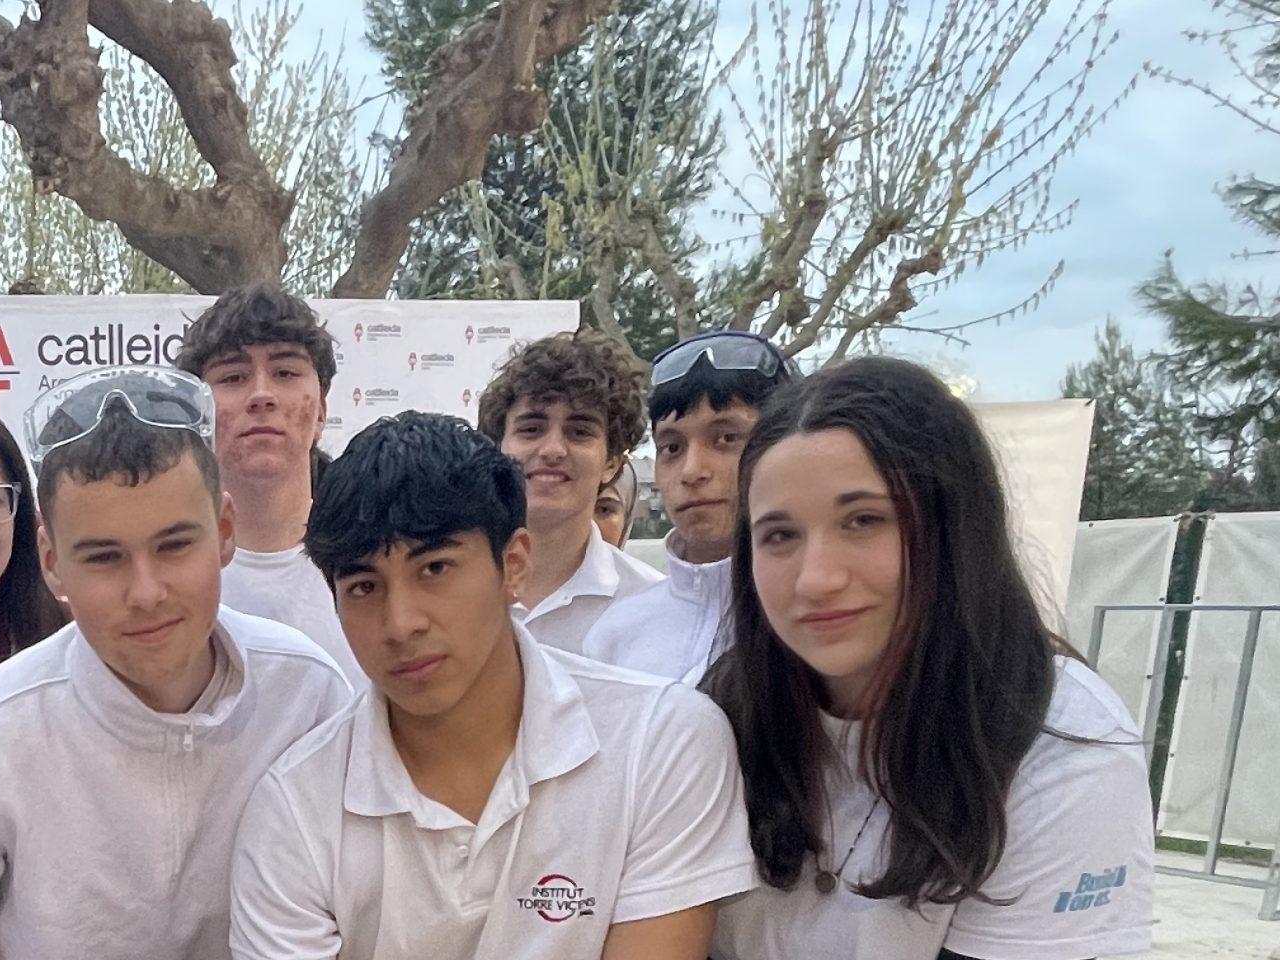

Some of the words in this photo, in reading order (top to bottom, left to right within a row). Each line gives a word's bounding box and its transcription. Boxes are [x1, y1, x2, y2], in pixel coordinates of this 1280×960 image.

[37, 323, 189, 366] catlleid
[531, 887, 584, 899] INSTITUT
[517, 898, 552, 910] TORRE
